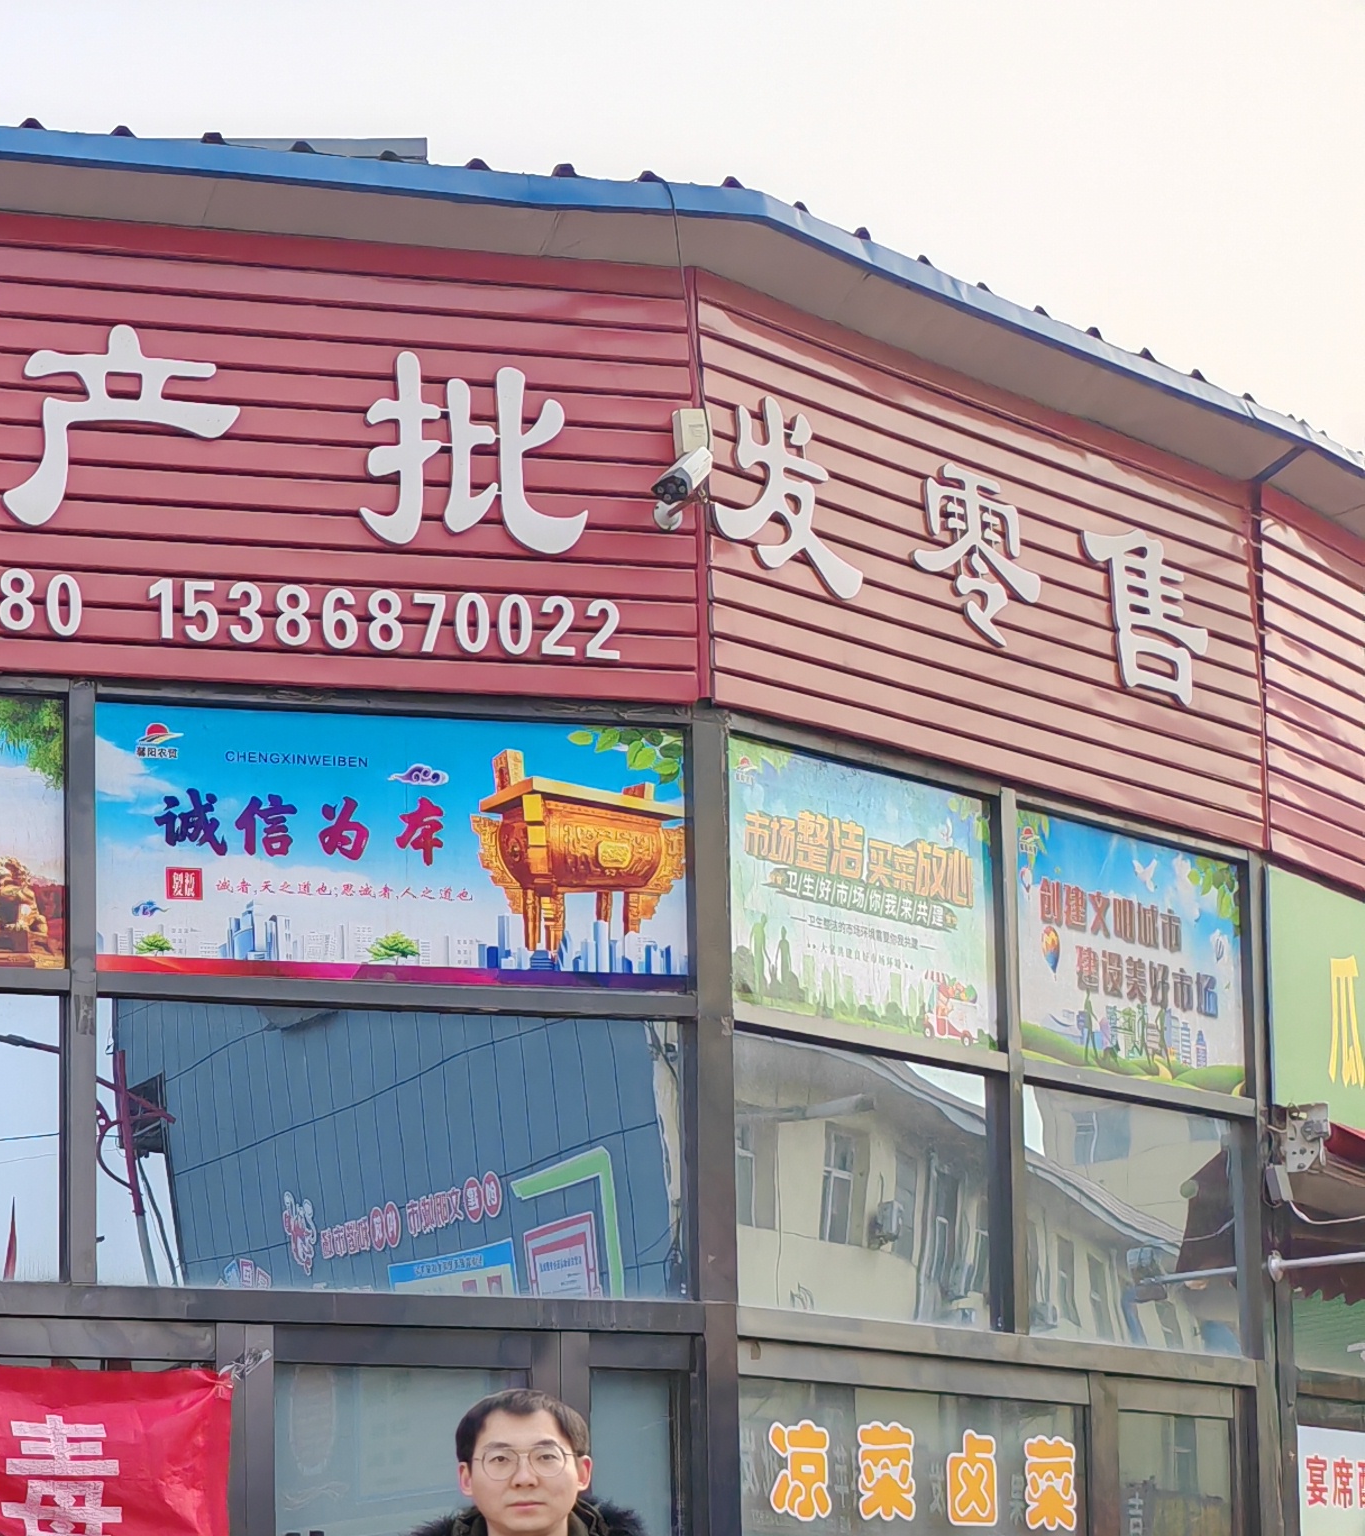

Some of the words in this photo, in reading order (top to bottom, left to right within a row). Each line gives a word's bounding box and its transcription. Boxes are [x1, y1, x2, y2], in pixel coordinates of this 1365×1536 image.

[150, 578, 623, 661] 15386870022
[225, 749, 369, 768] CHENGXINWEIBEN
[154, 787, 444, 866] 诚信为本
[1075, 944, 1218, 1018] 建设美好市场
